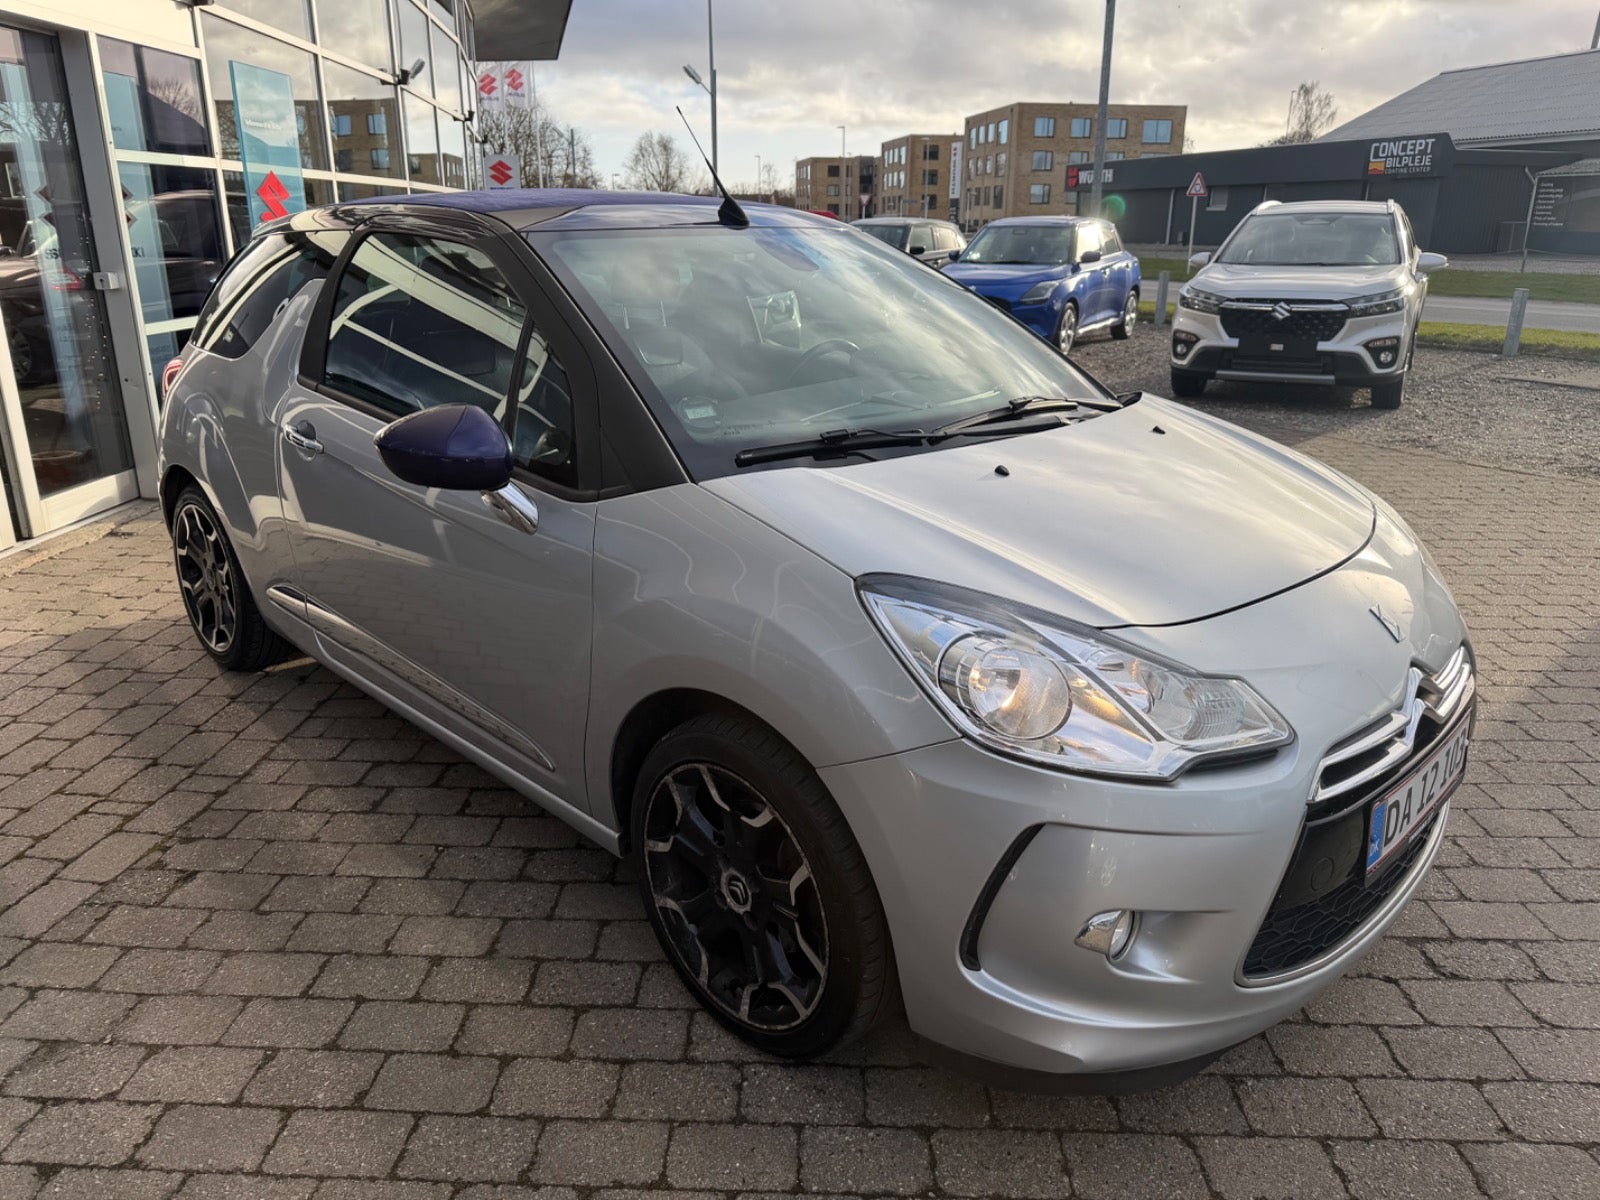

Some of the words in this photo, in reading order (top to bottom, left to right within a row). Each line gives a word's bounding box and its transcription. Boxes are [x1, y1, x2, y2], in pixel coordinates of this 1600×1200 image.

[1370, 138, 1436, 161] CONCEPT
[1385, 155, 1433, 168] BILPLEJE
[1384, 786, 1412, 848] DA
[1417, 760, 1439, 815] 12
